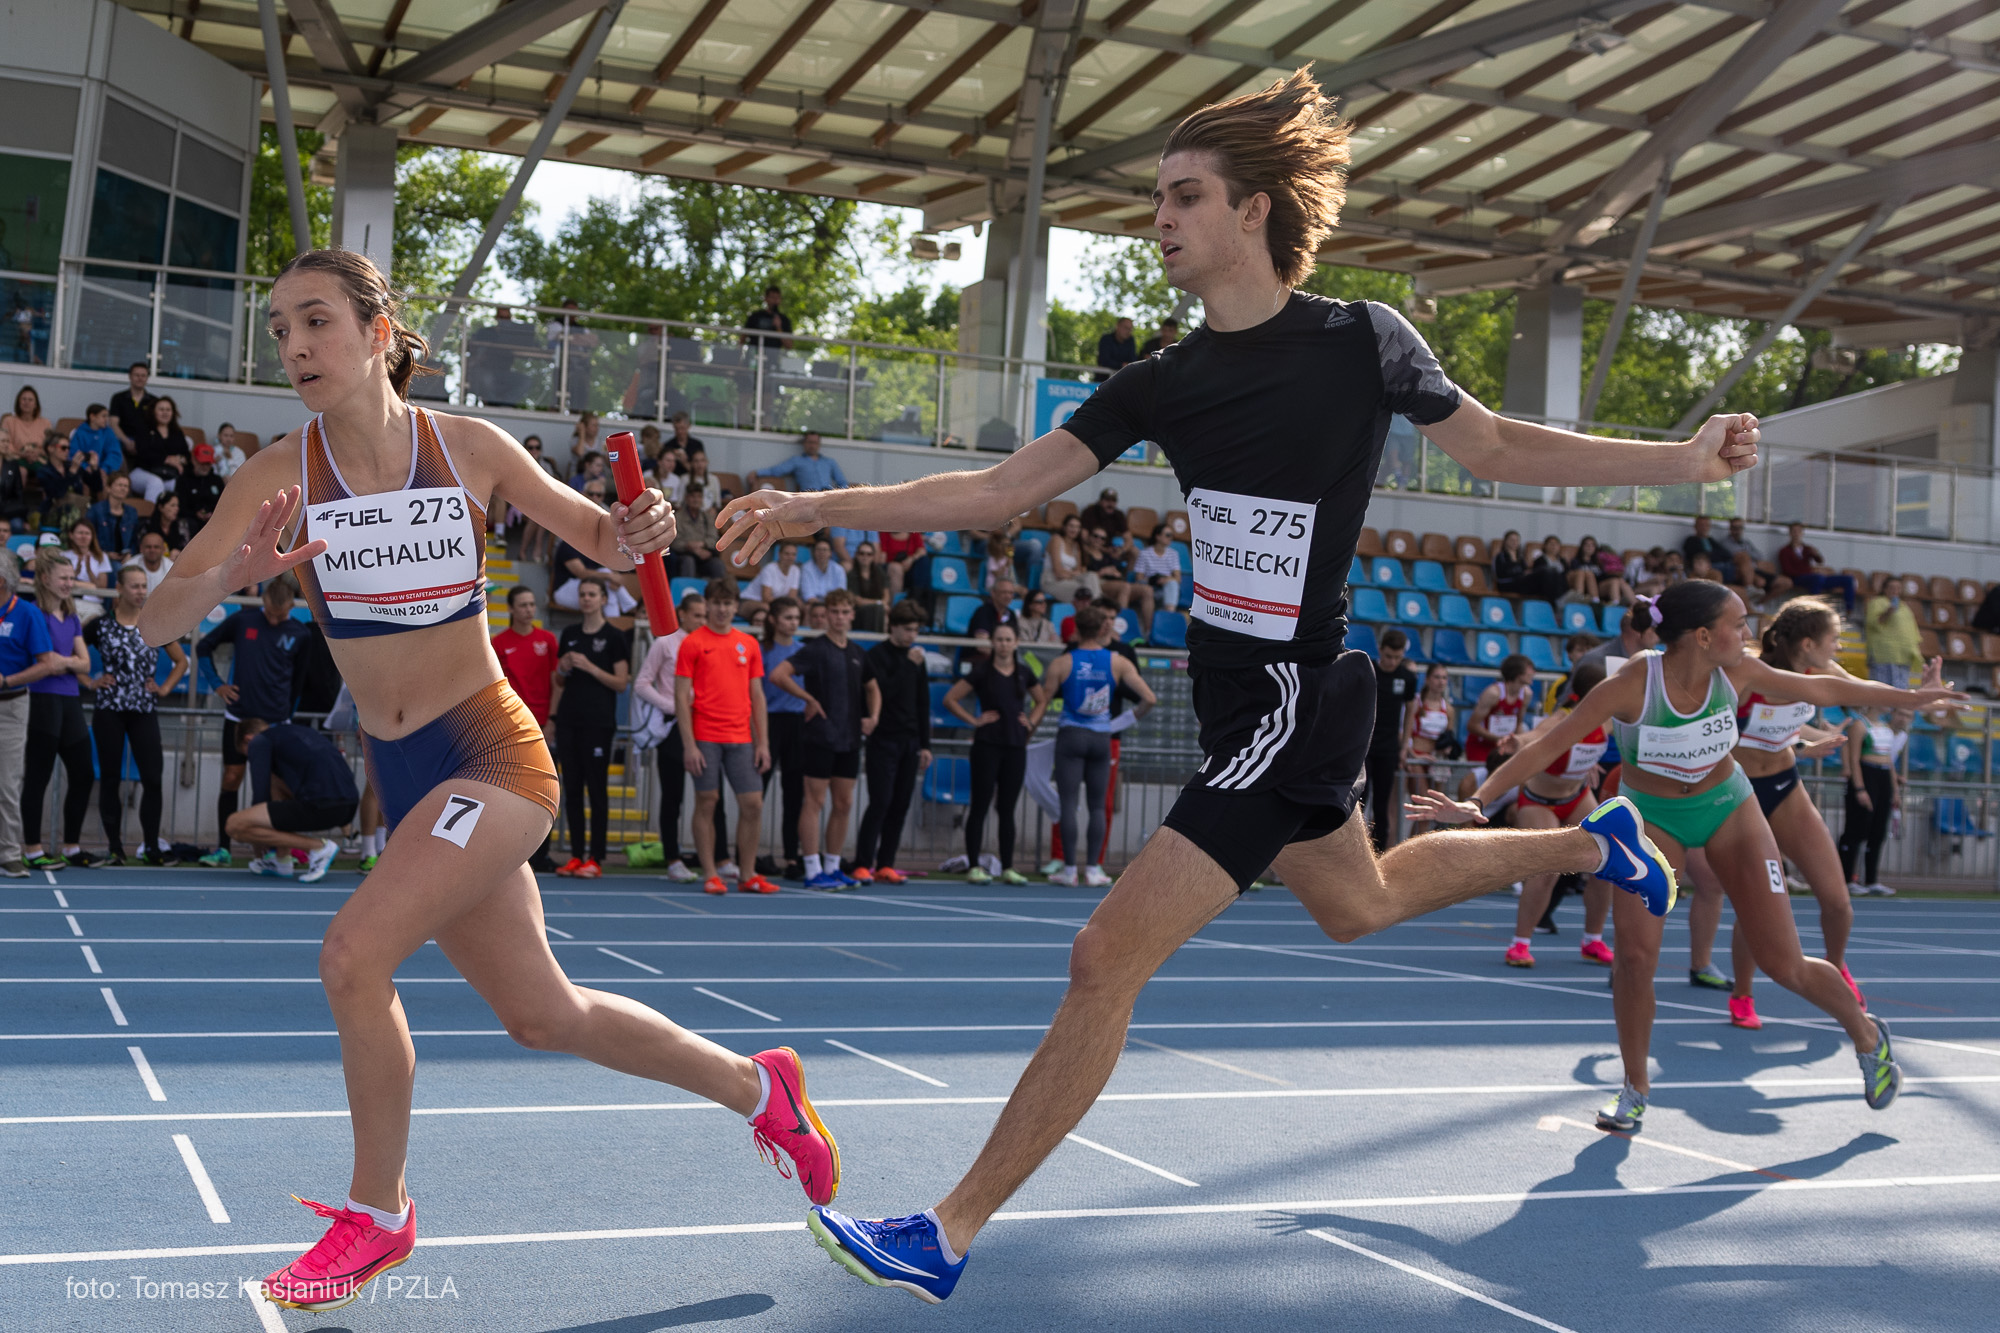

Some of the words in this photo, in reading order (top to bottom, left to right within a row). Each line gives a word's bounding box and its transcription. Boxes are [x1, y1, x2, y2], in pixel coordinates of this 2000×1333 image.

[1325, 317, 1356, 328] Reebok
[315, 510, 335, 522] 4F
[334, 508, 392, 529] FUEL
[408, 497, 464, 526] 273
[1191, 497, 1202, 508] 4F
[1201, 503, 1237, 525] FUEL
[1249, 508, 1307, 540] 275
[324, 536, 466, 572] MICHALUK
[1195, 538, 1300, 578] STRZELECKI
[405, 590, 441, 600] SZTAFETACH
[441, 583, 474, 595] MIESZANYCH
[369, 606, 407, 616] LUBLIN
[409, 603, 439, 616] 2024
[1206, 604, 1231, 620] LUBLIN
[1231, 611, 1254, 625] 2024
[1259, 604, 1296, 614] MIESZANYCH
[1702, 715, 1733, 737] 335
[1644, 741, 1730, 760] KANAKANTI
[443, 796, 479, 832] 7
[1770, 862, 1781, 887] 5
